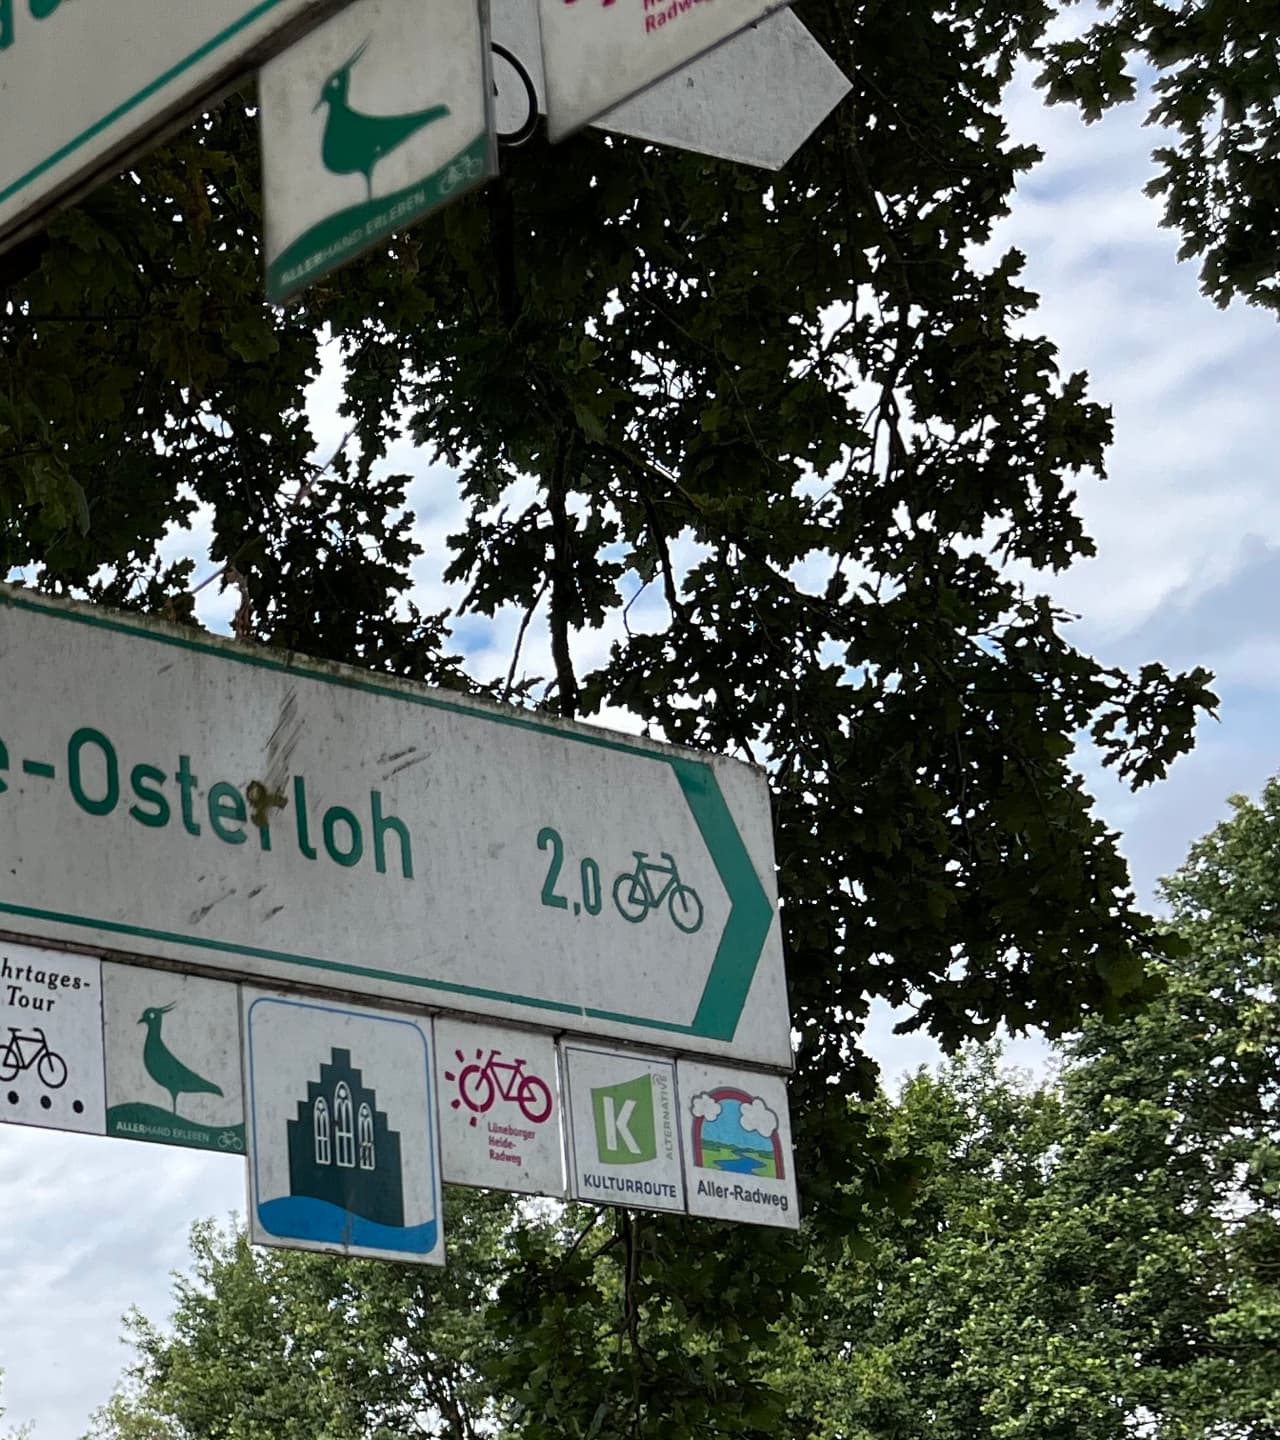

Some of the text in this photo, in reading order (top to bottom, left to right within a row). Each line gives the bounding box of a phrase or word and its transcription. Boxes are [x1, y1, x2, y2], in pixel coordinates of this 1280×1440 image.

[644, 0, 713, 34] Radw
[536, 826, 602, 916] 2,0
[6, 984, 56, 1012] Tour
[115, 1121, 171, 1137] ALLERHAND
[602, 1096, 641, 1155] K
[660, 1073, 674, 1161] ALTERNATIVE
[489, 1149, 522, 1167] Radweg
[583, 1174, 677, 1198] KULTURROUTE
[697, 1179, 789, 1211] Aller-Radweg
